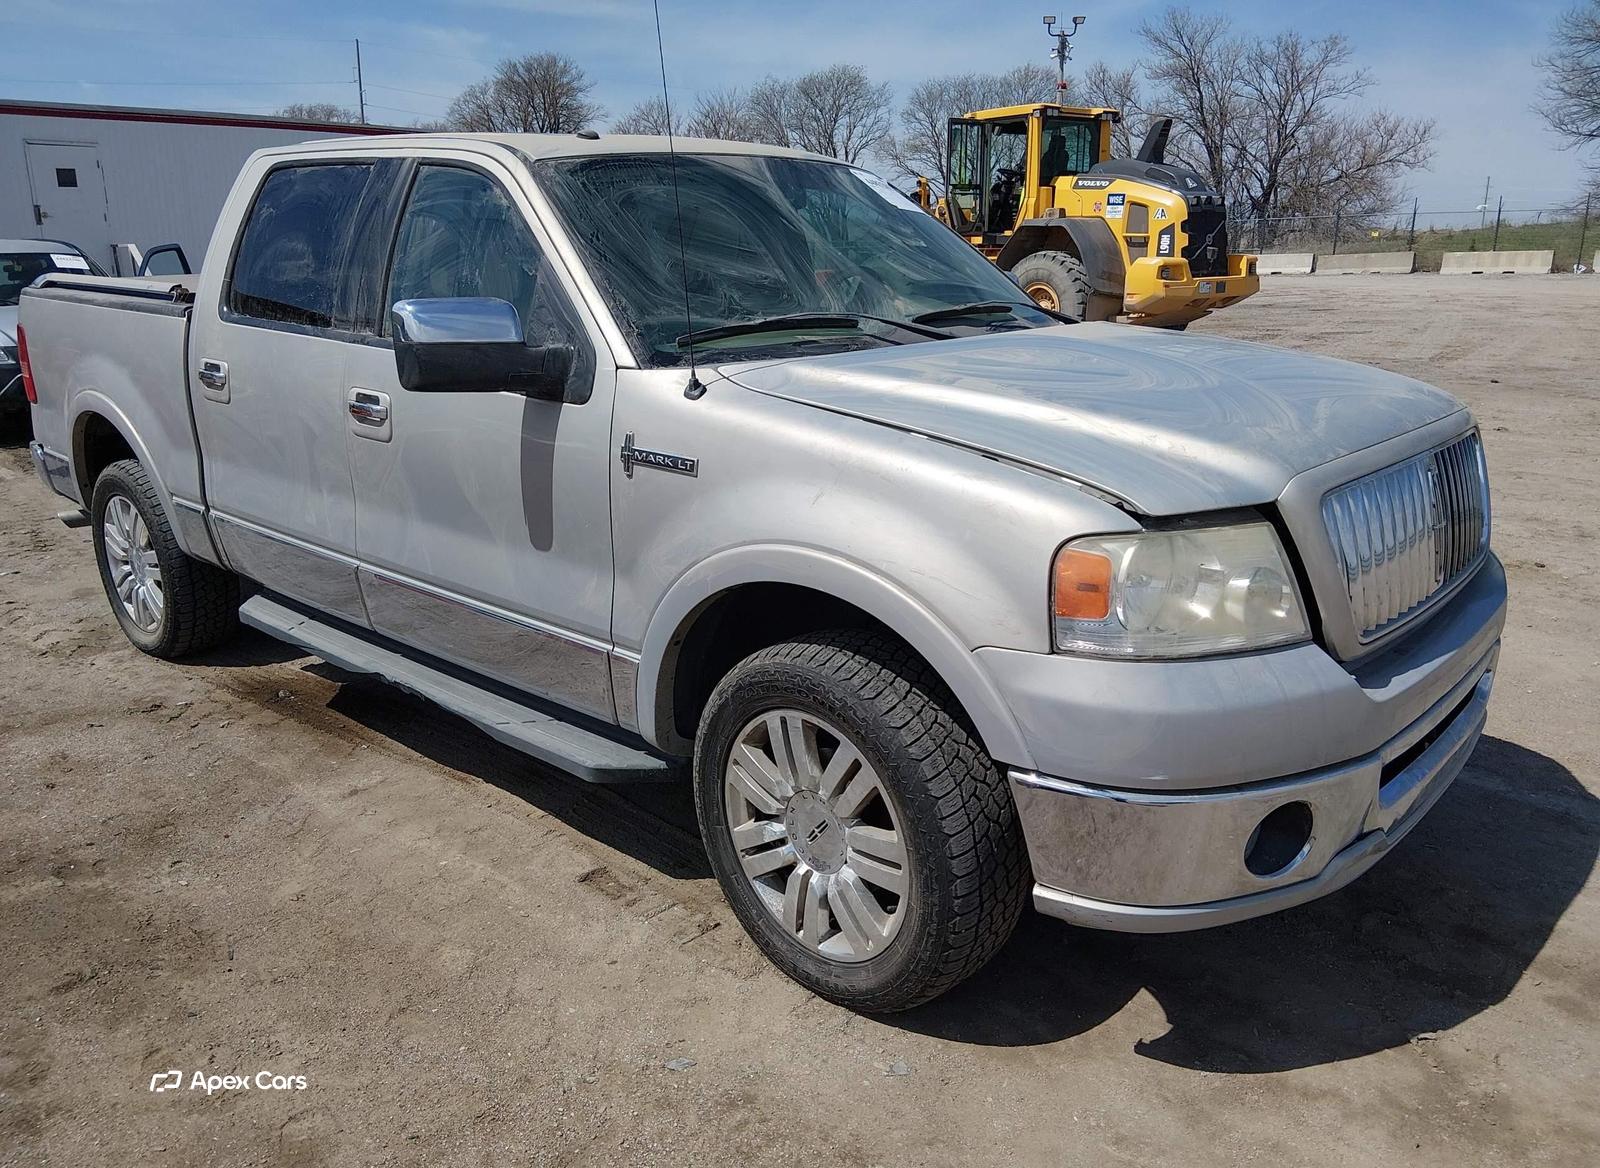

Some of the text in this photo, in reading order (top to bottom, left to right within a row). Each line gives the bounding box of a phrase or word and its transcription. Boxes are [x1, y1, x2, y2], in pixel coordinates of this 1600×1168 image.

[1108, 195, 1124, 204] WISE
[1159, 234, 1171, 254] L90H
[634, 451, 694, 470] MARK LT
[734, 682, 848, 724] PATAGONIA
